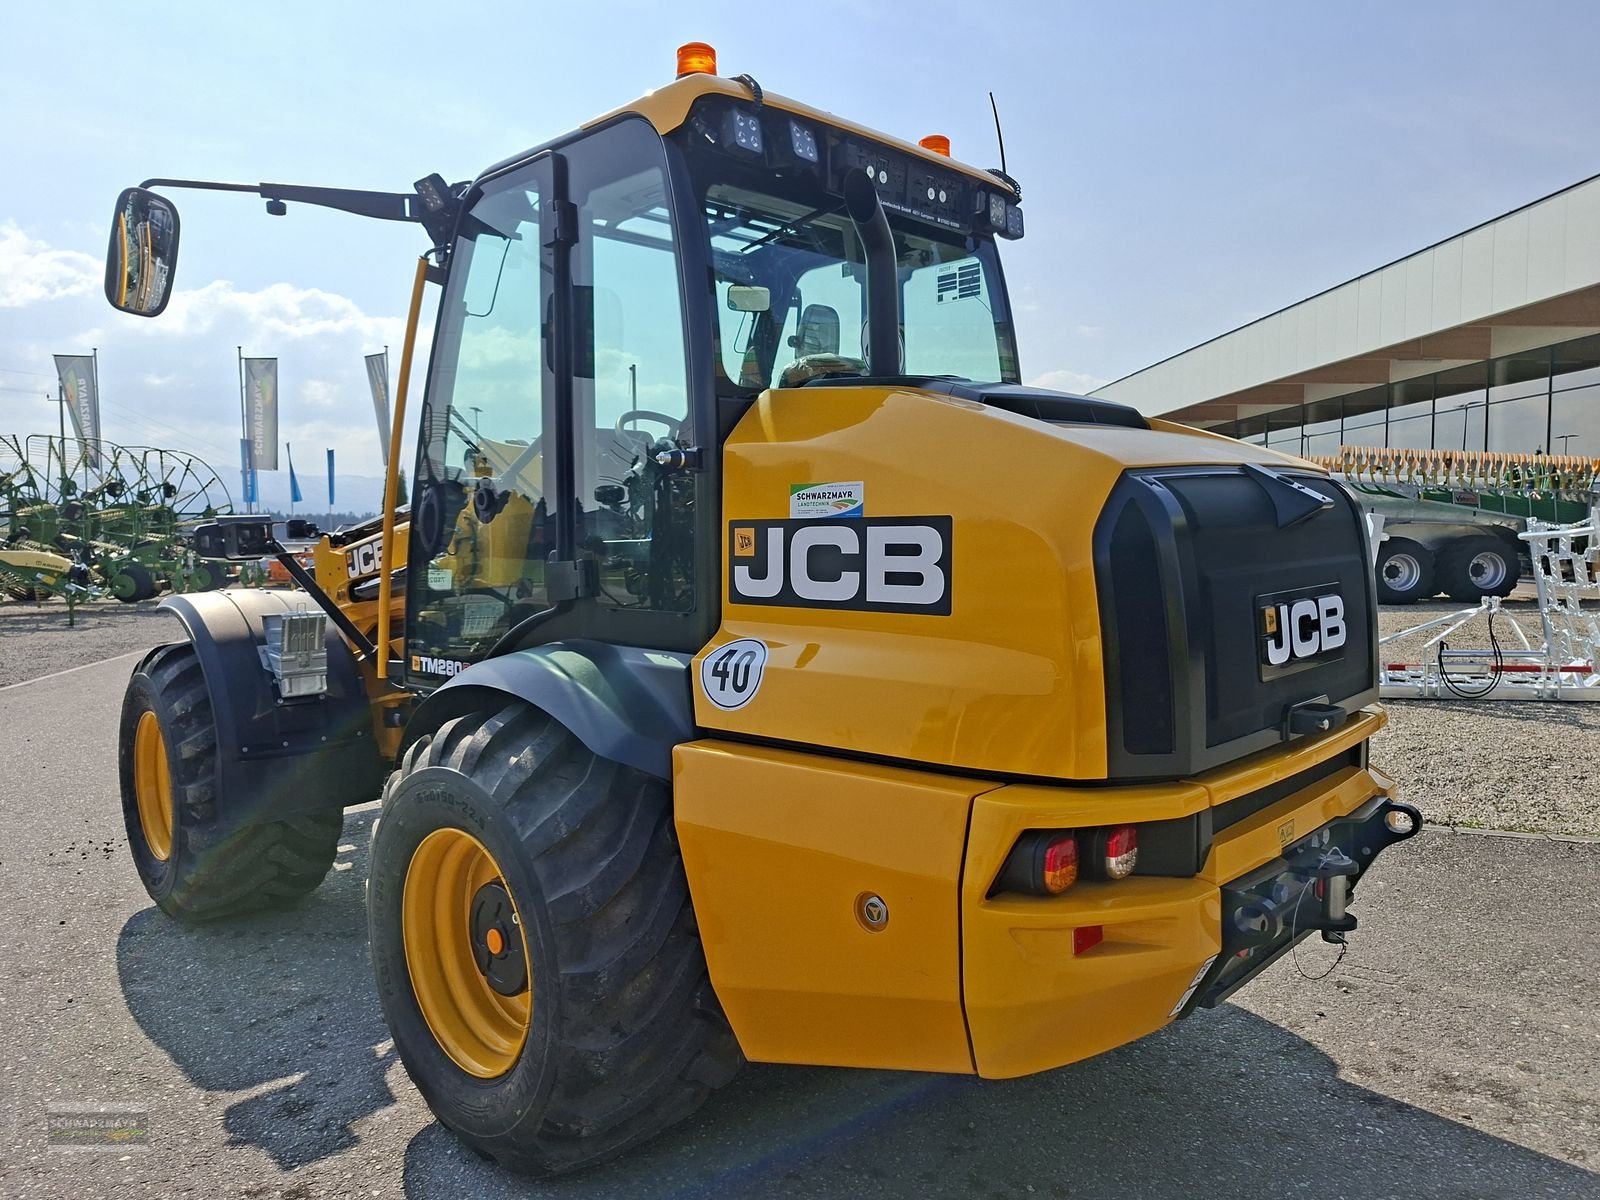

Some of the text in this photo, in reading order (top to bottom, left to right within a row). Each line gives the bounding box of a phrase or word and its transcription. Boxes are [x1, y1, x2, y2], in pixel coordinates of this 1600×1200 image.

[796, 490, 853, 501] SCHWARZMAYR
[734, 525, 945, 605] JCB
[1267, 595, 1347, 665] JCB
[711, 648, 757, 694] 40
